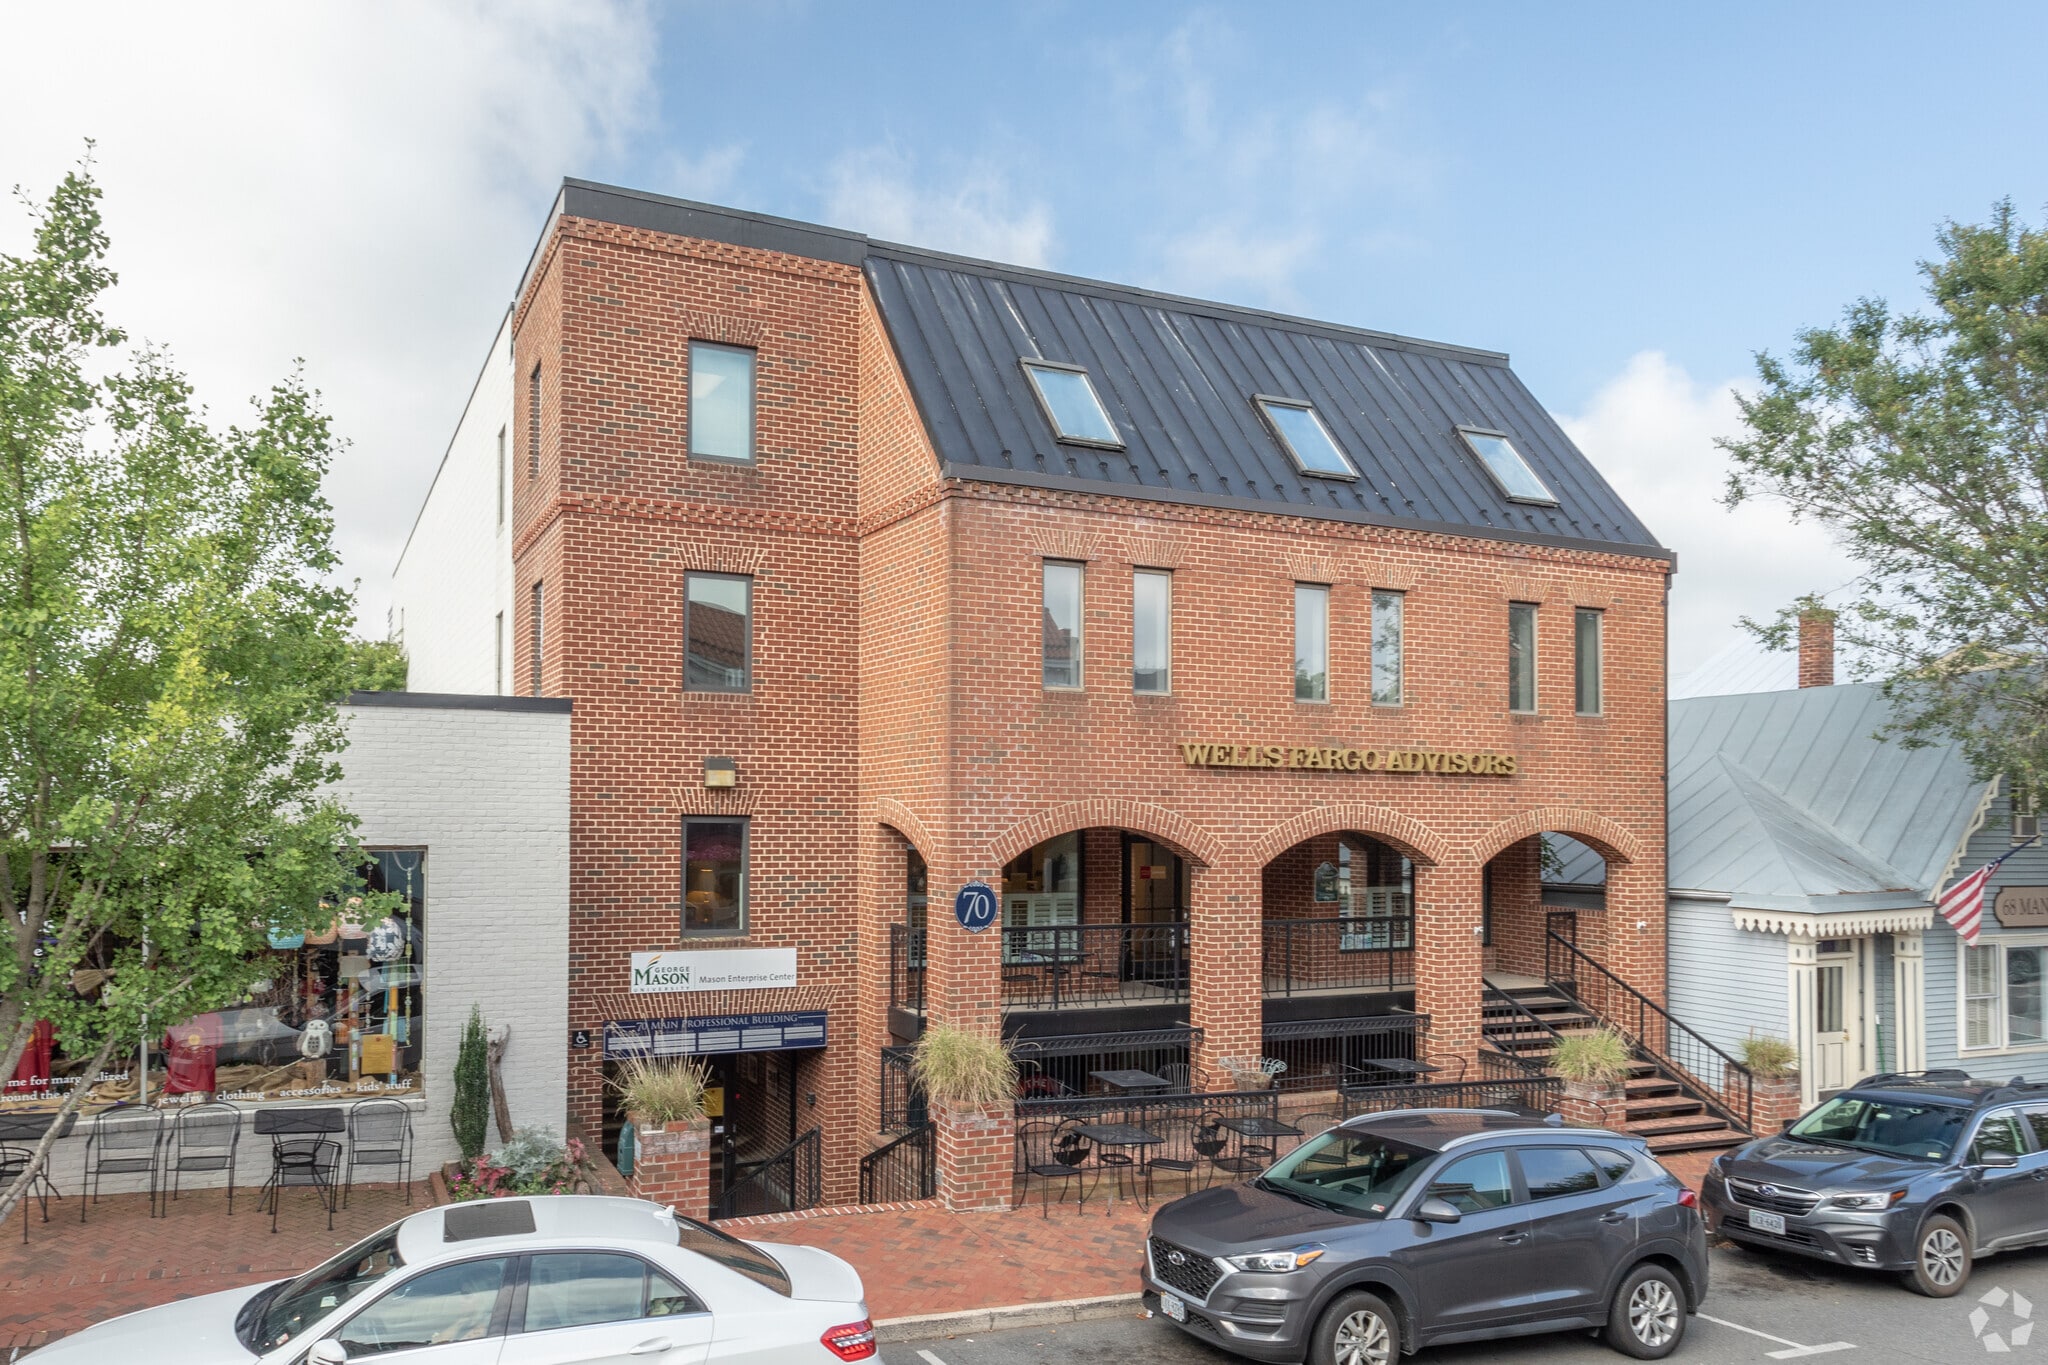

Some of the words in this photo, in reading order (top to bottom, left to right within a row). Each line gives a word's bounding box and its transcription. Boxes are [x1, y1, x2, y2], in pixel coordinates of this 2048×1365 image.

[1180, 742, 1284, 768] WELLS
[1287, 747, 1381, 771] FARGO
[1384, 751, 1518, 775] ADVISORS
[962, 891, 990, 924] 70
[2003, 898, 2017, 916] 68
[634, 967, 690, 986] MASON
[699, 975, 726, 984] Mason
[728, 974, 768, 983] Enterprise
[769, 972, 795, 981] Center
[651, 1020, 679, 1029] MAIN
[682, 1016, 749, 1028] PROFESSIONAL
[752, 1014, 798, 1024] BUILDING
[30, 1075, 49, 1086] for
[41, 1090, 60, 1100] the
[158, 1092, 204, 1108] jewelry
[216, 1089, 266, 1101] clothing
[280, 1084, 341, 1097] accessories
[385, 1078, 413, 1090] stuff
